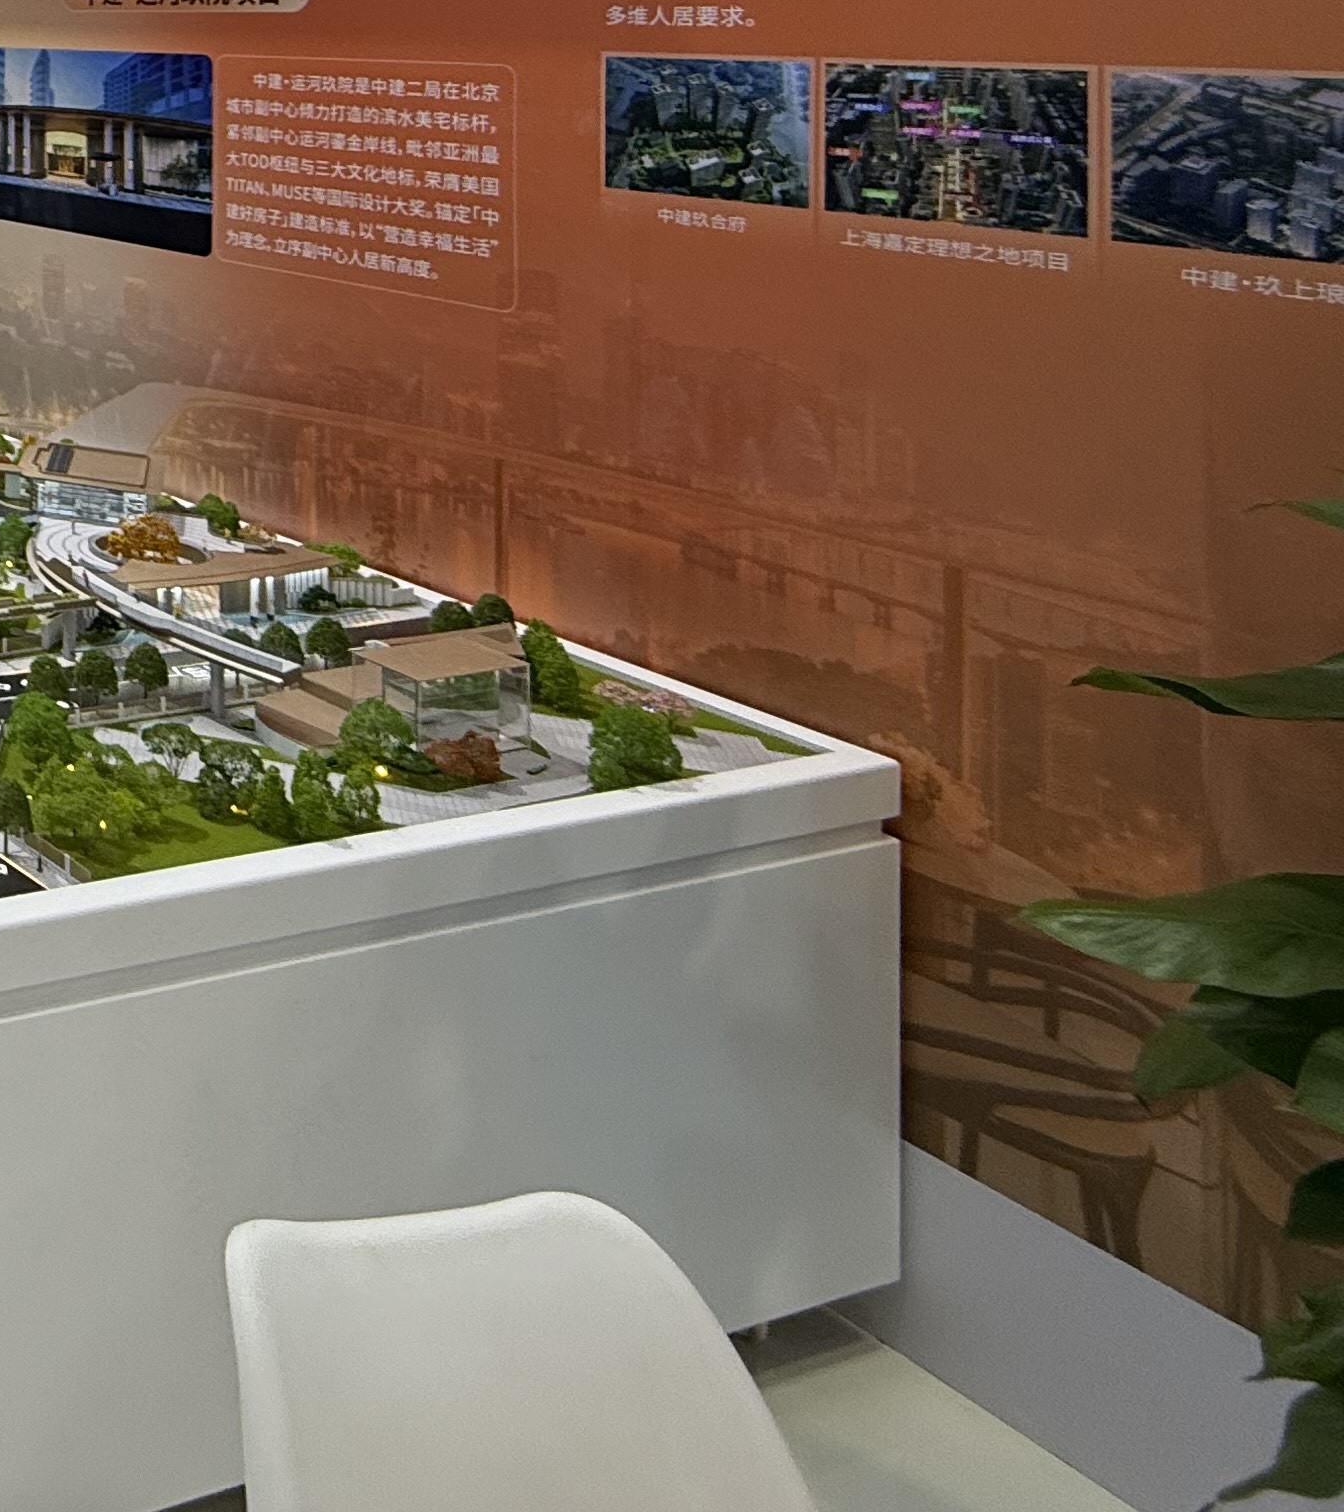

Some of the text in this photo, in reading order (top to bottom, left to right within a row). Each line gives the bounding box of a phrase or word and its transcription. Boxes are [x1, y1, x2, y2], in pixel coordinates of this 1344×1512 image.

[605, 4, 756, 29] 多维人居要求。
[840, 228, 1070, 272] 上海嘉定理想之地项目
